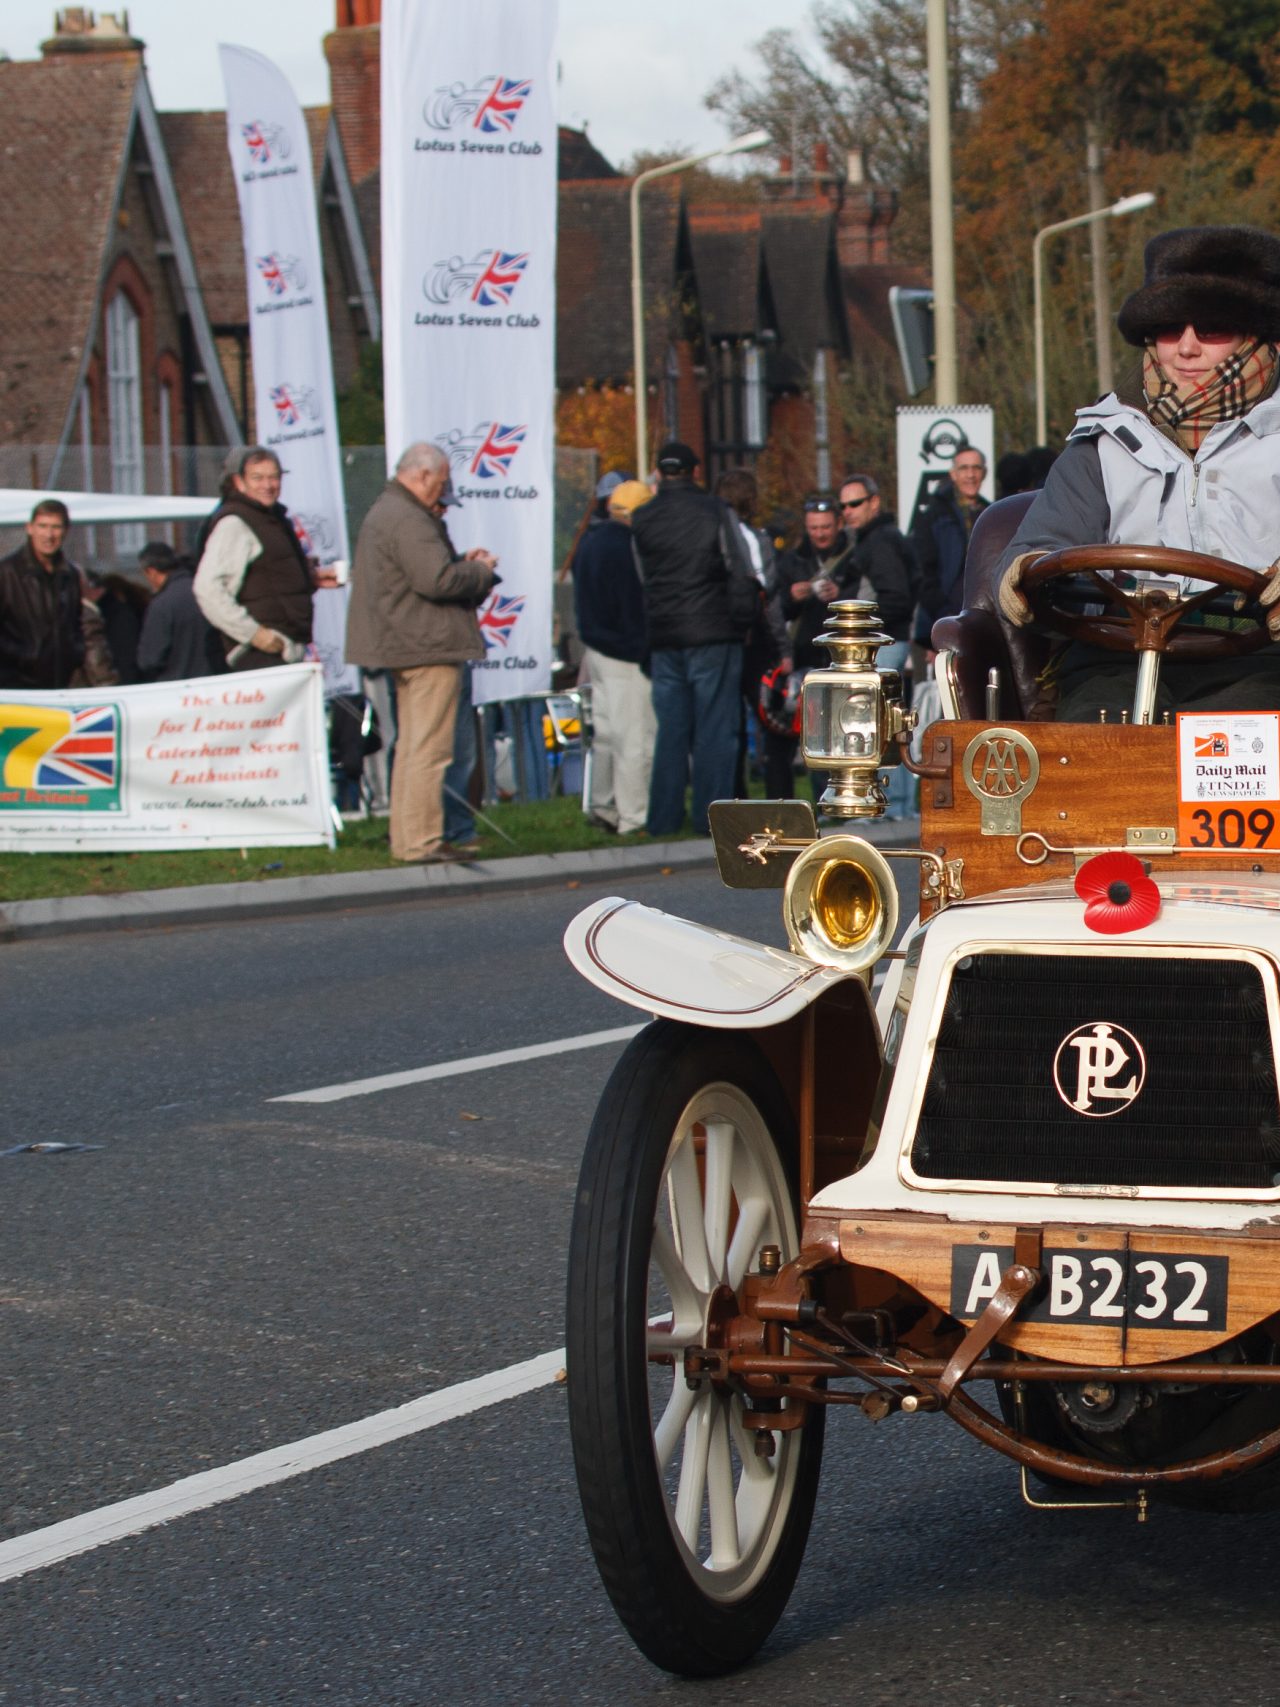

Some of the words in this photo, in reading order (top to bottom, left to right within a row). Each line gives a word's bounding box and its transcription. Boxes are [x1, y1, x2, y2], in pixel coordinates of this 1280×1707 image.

[414, 138, 455, 152] Lotus
[460, 139, 505, 153] Seven
[508, 140, 542, 155] Club
[414, 312, 454, 325] Lotus
[458, 313, 502, 326] Seven
[506, 314, 540, 328] Club
[458, 485, 500, 498] Seven
[504, 486, 538, 500] Club
[503, 656, 538, 669] Club
[182, 694, 213, 708] The
[222, 689, 266, 706] Club
[156, 718, 186, 739] for
[192, 717, 245, 733] Lotus
[250, 711, 286, 730] and
[145, 742, 241, 760] Caterham
[250, 740, 299, 753] Seven
[169, 766, 280, 785] Enthusiasts
[1196, 764, 1232, 779] Daily
[1235, 764, 1267, 776] Mail
[1206, 781, 1267, 791] TINDLE
[1190, 808, 1275, 849] 309
